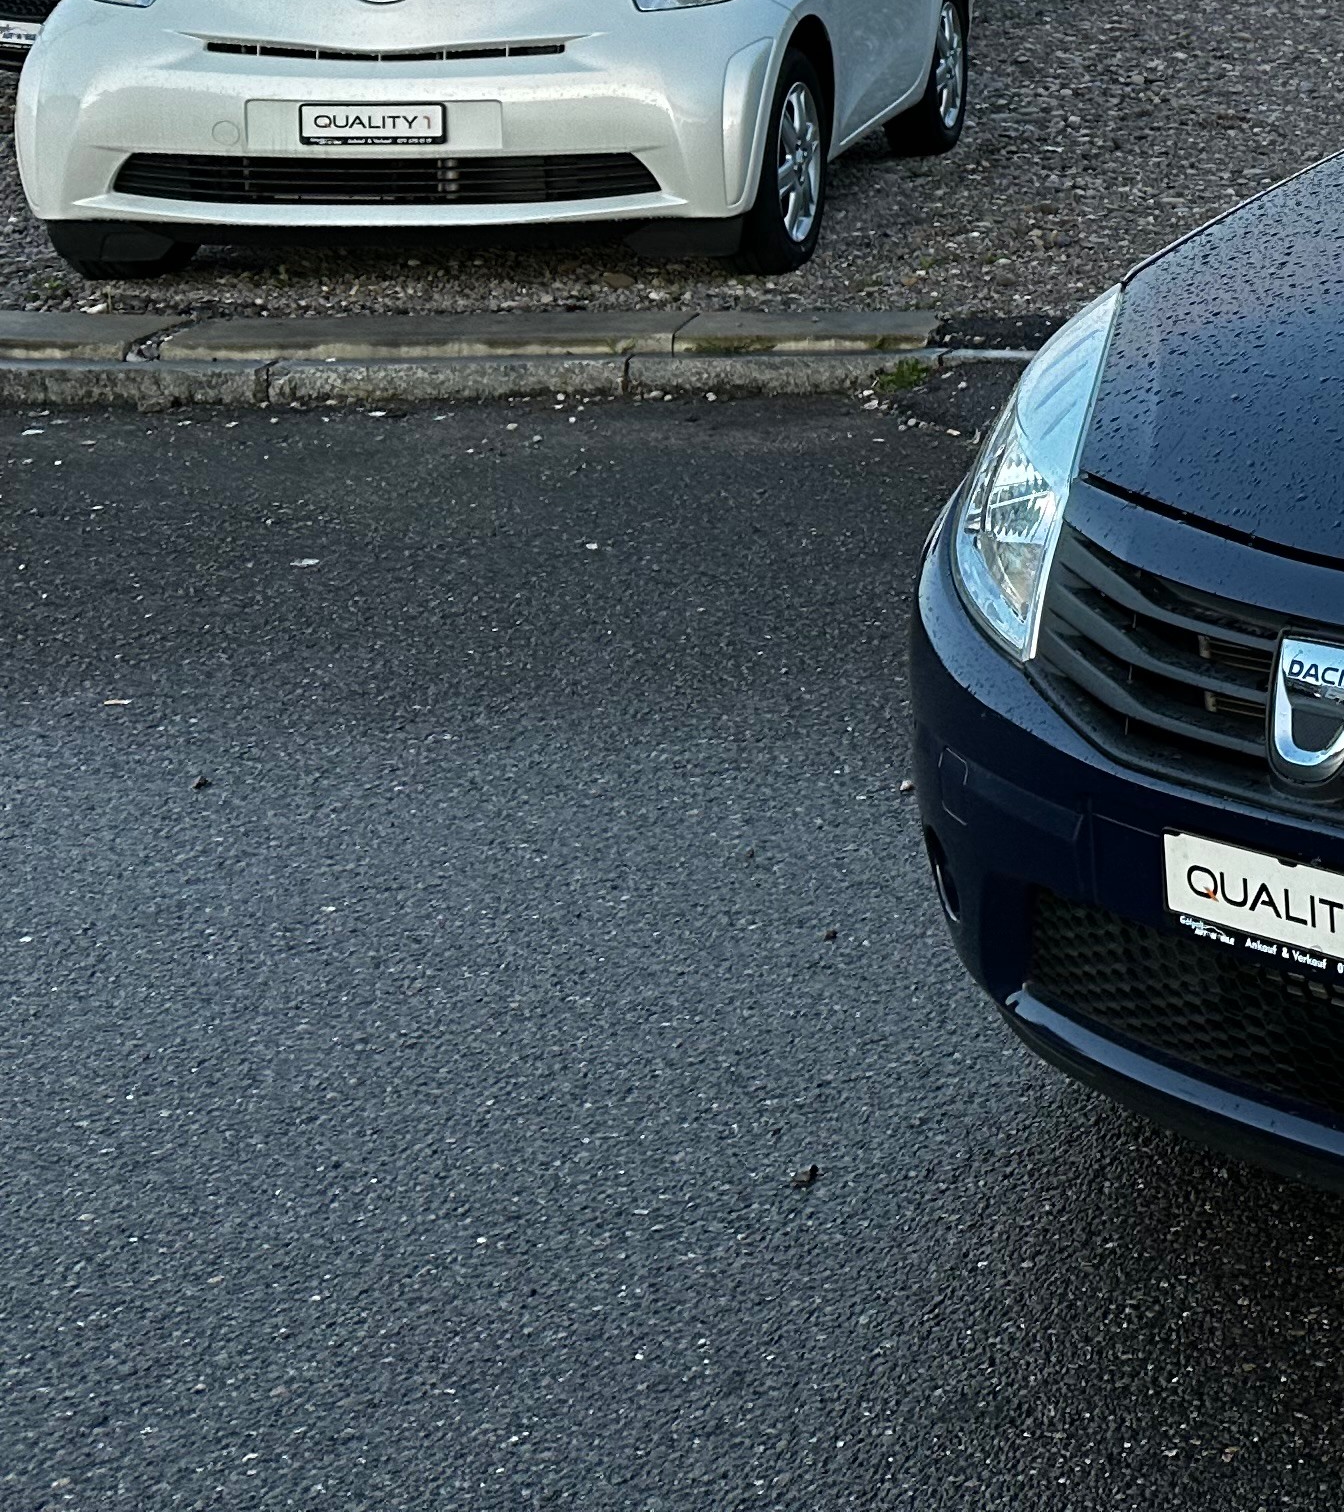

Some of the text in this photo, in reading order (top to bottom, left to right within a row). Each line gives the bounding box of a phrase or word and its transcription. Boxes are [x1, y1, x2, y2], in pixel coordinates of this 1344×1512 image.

[313, 115, 418, 129] QUALITY
[1245, 937, 1278, 955] Ankauf
[1282, 947, 1290, 959] &
[1292, 949, 1328, 969] Verkauf
